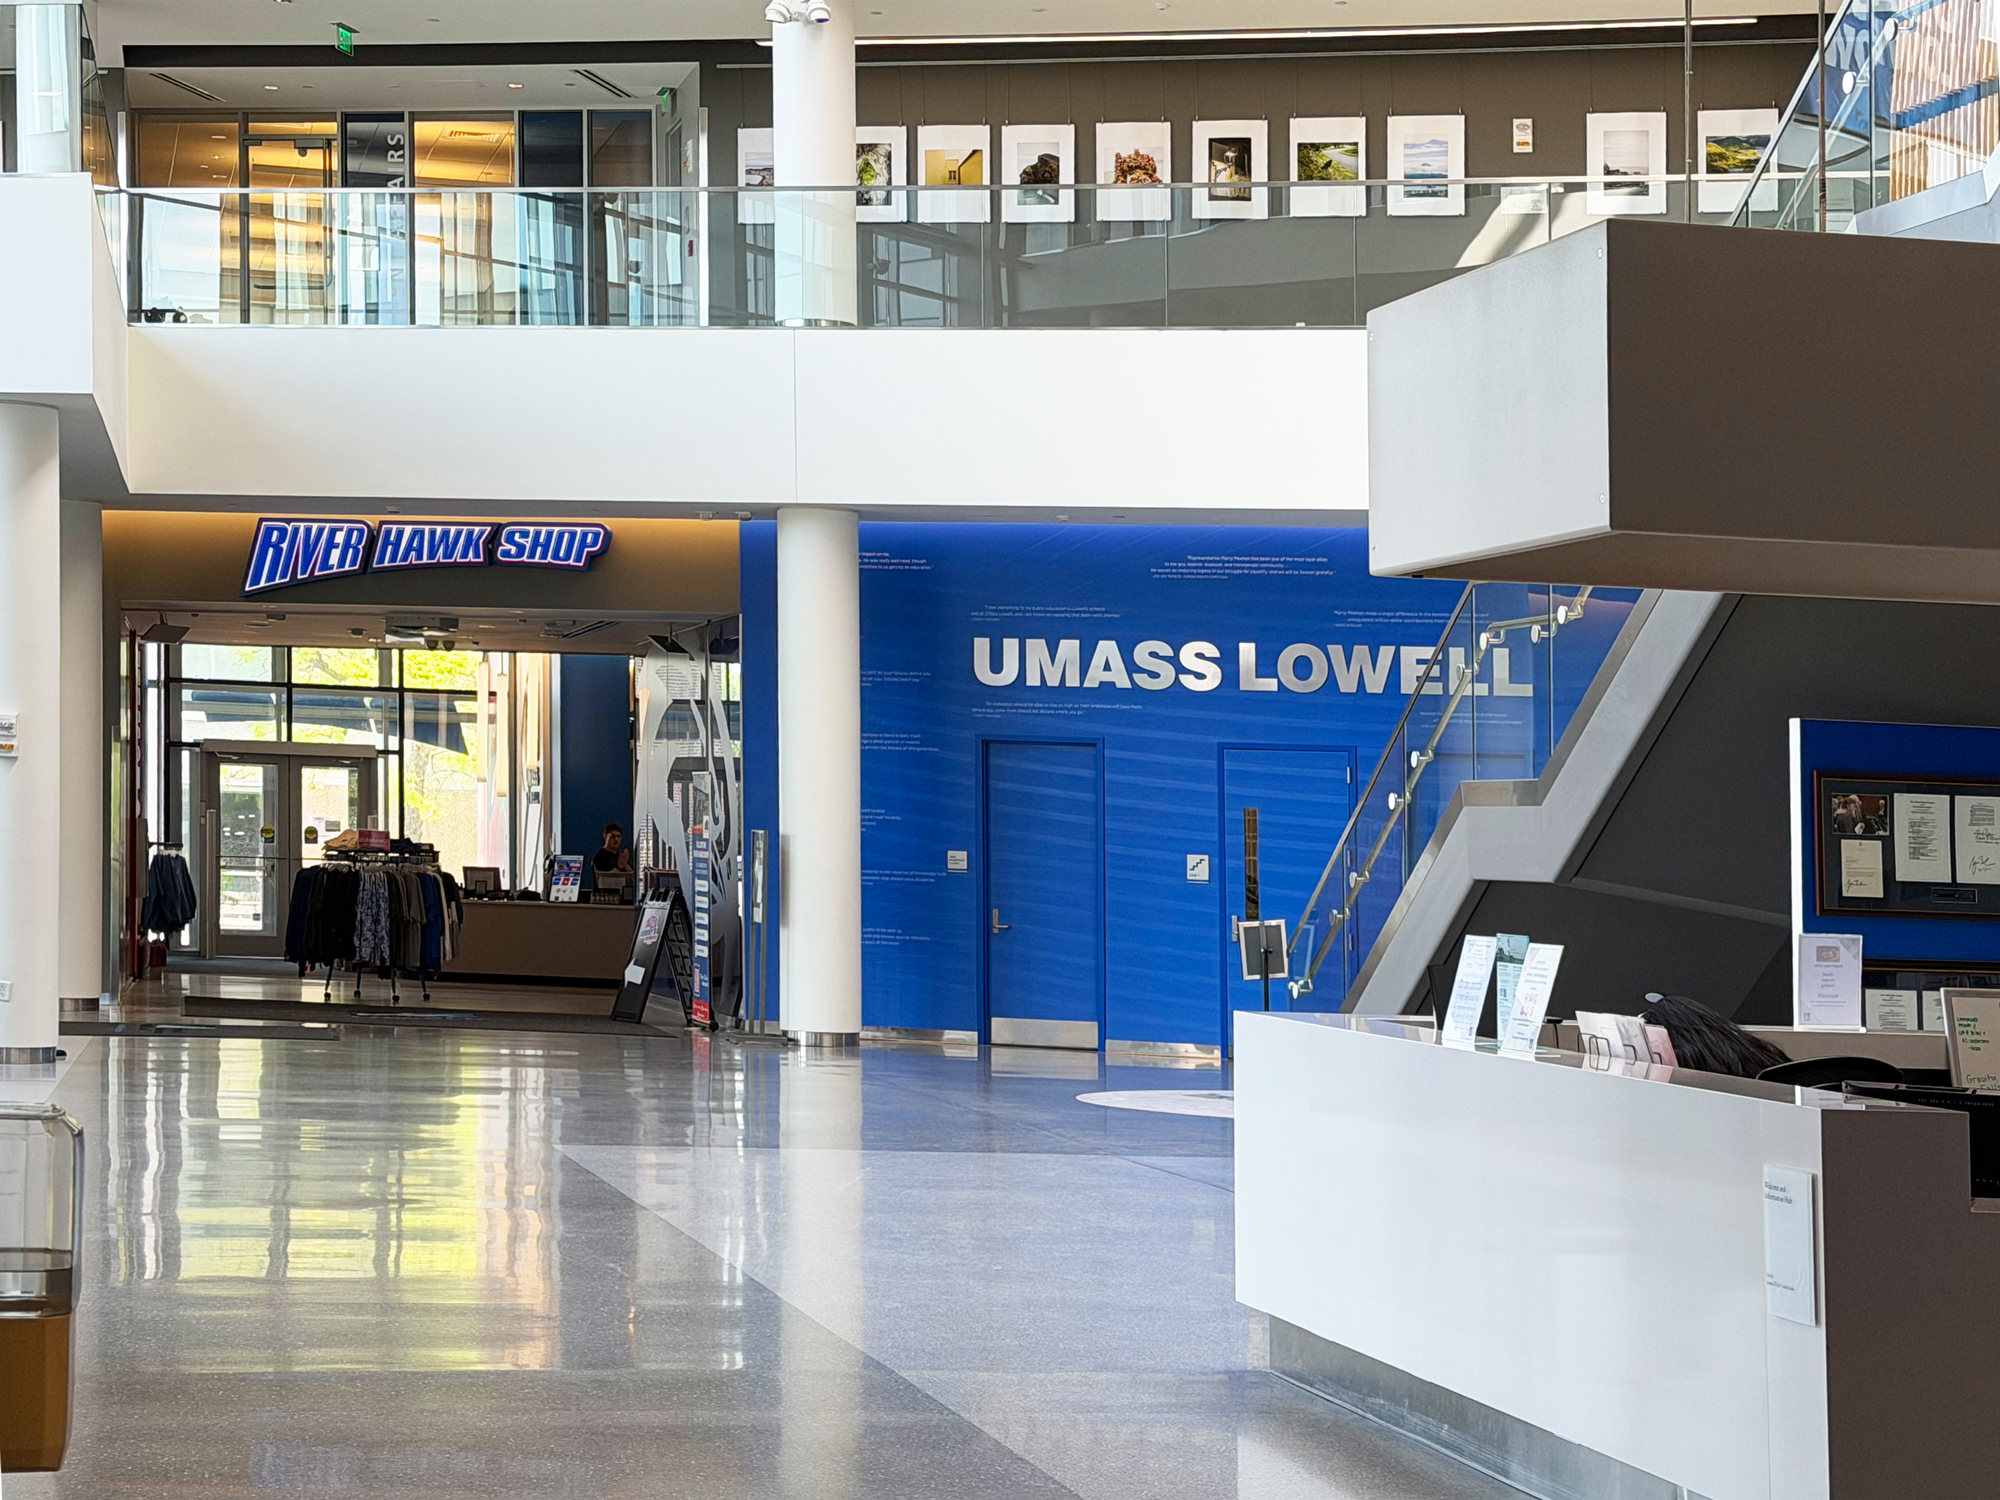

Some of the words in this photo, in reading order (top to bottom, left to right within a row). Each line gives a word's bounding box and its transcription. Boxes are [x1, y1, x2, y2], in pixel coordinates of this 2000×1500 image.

[245, 520, 367, 592] RIVER
[372, 524, 489, 569] HAWK
[497, 526, 603, 568] SHOP
[972, 636, 1223, 692] UMASS
[1238, 642, 1534, 698] LOWELL
